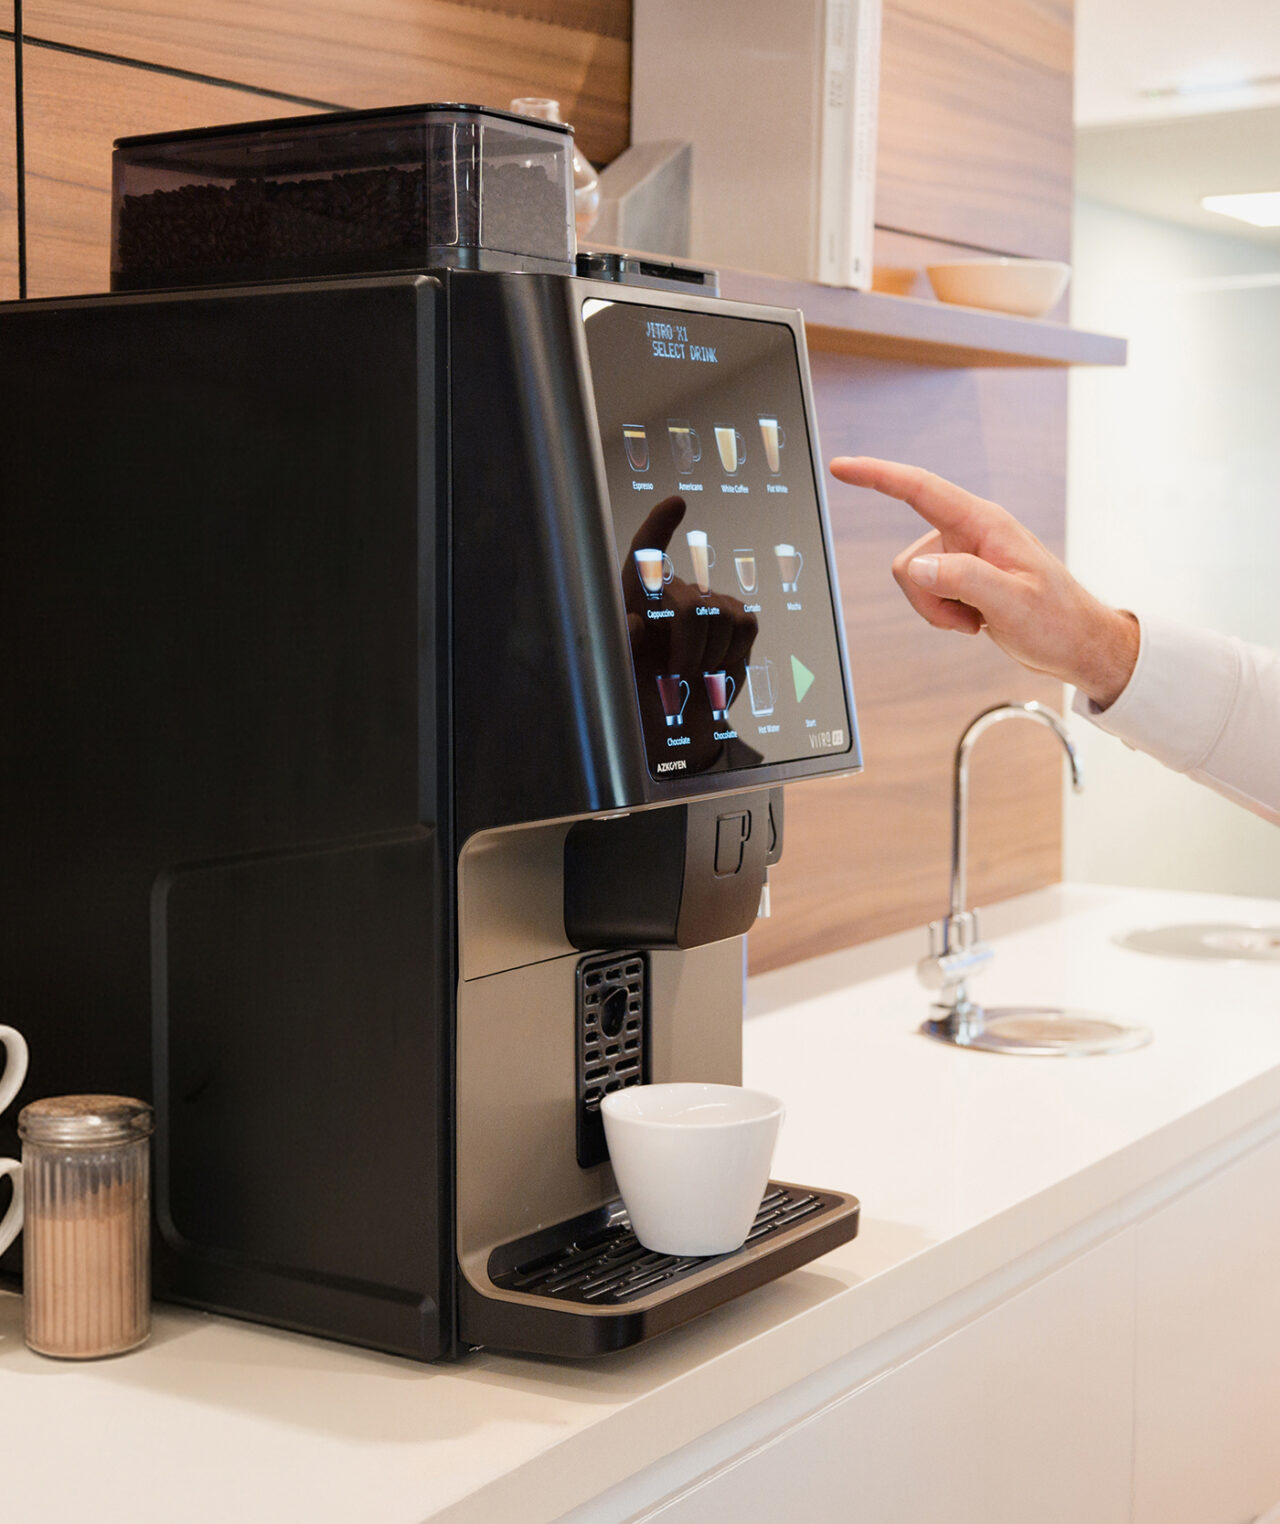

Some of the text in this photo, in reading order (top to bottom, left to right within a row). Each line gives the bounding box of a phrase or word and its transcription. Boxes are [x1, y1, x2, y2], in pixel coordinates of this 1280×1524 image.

[676, 325, 689, 342] X1
[652, 340, 719, 363] SELECT DRINK
[632, 480, 654, 491] Espresso
[678, 481, 704, 491] Americano
[646, 608, 675, 619] Cappuccino
[666, 736, 691, 747] Chocolate
[657, 760, 687, 773] AZKOYEN
